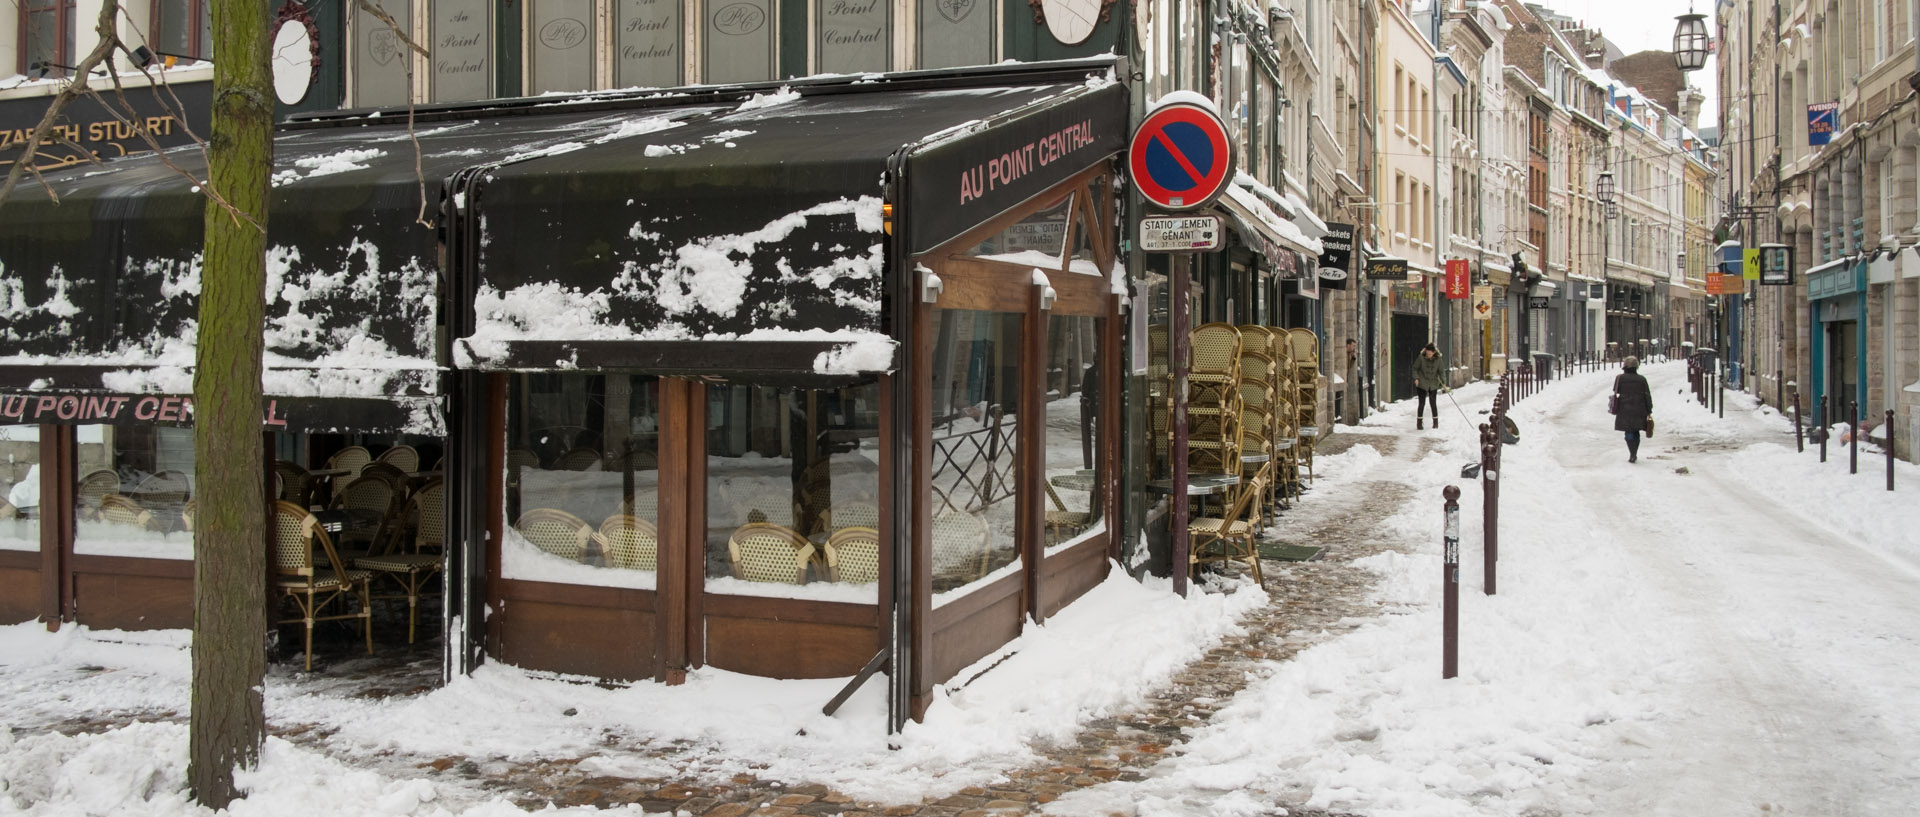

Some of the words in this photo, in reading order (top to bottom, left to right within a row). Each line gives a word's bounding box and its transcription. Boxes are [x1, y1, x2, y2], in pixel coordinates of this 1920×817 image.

[450, 13, 470, 23] Au
[626, 16, 670, 33] Point
[440, 33, 480, 48] Point
[823, 27, 882, 45] Central
[622, 42, 674, 60] Central
[437, 58, 485, 74] Central
[88, 116, 175, 142] STUART
[960, 164, 983, 206] AU
[988, 142, 1035, 191] POINT
[1038, 118, 1095, 167] CENTRAL
[1145, 219, 1213, 230] STATIOEMENT
[1329, 254, 1338, 262] by
[34, 396, 130, 420] POINT
